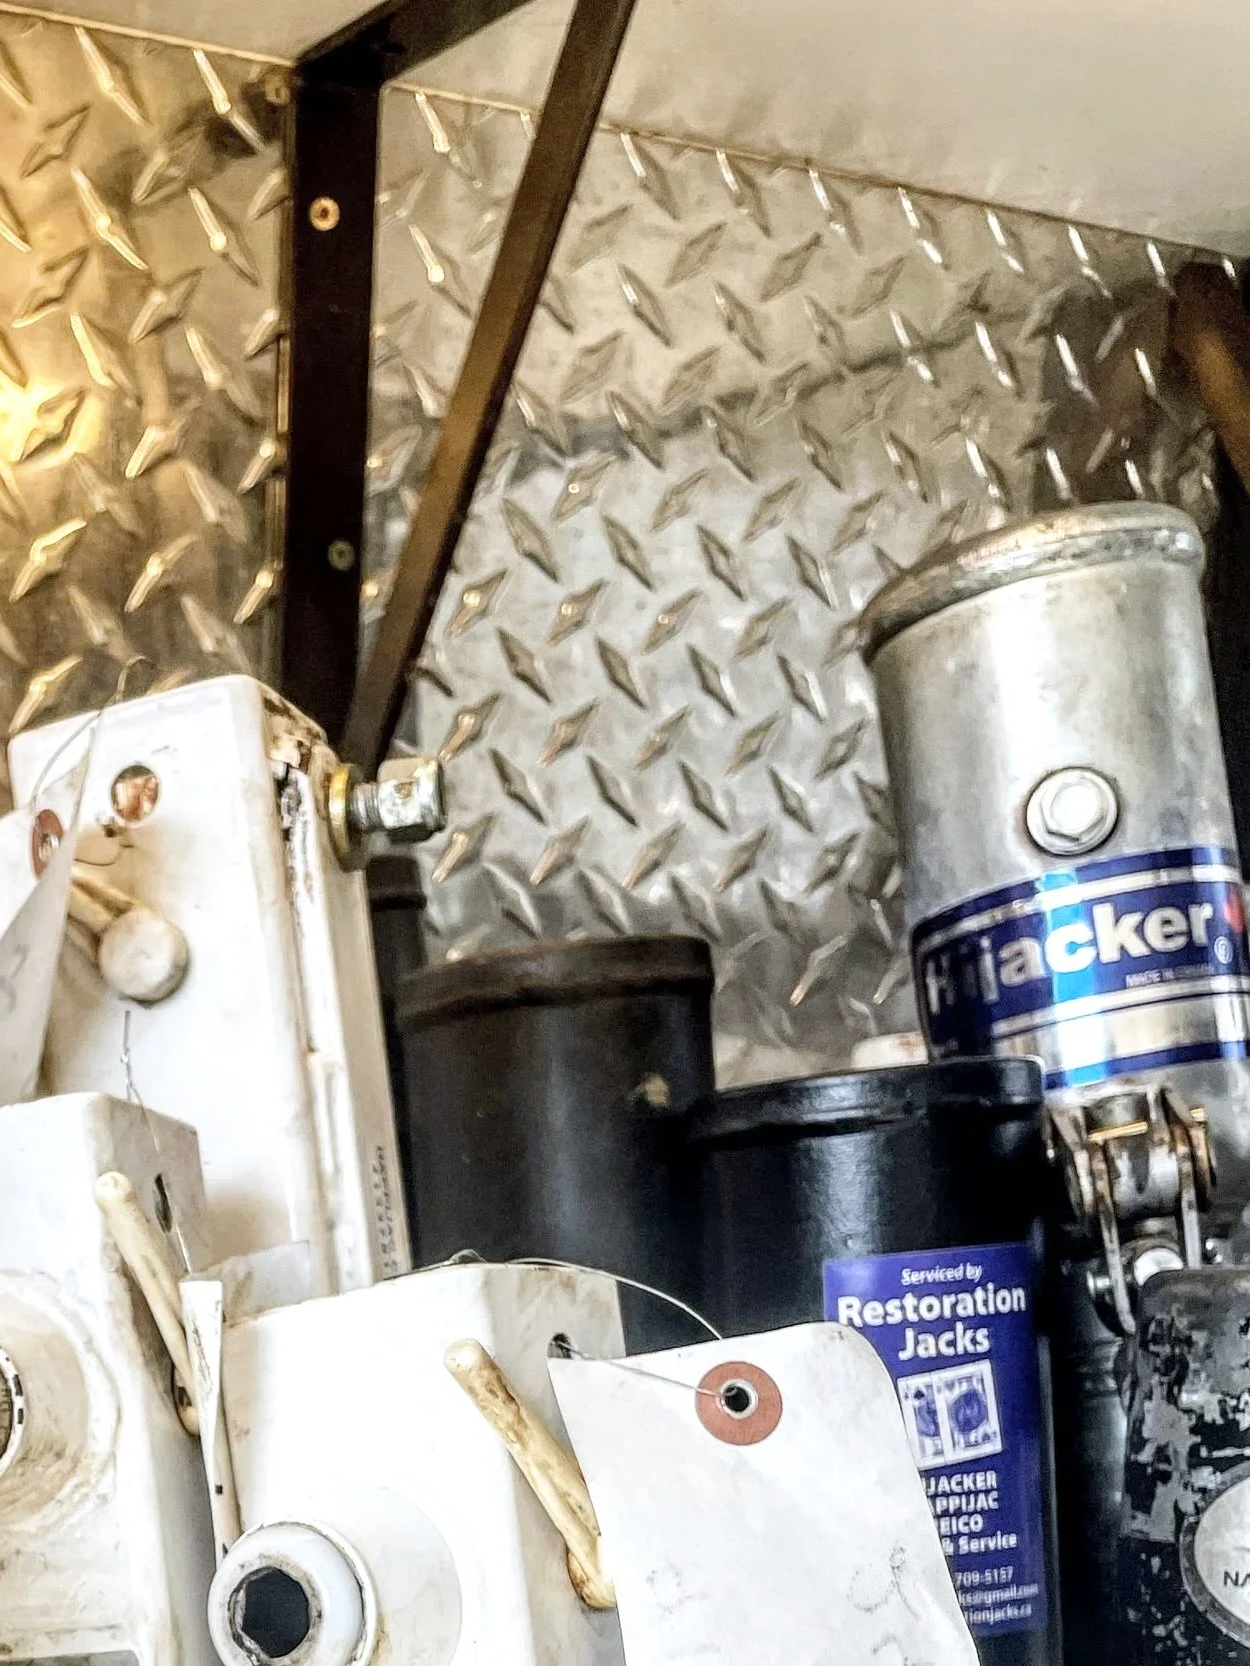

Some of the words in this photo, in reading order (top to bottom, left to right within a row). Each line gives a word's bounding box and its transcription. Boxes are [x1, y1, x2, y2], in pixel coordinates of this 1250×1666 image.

[901, 1263, 963, 1286] Serviced
[966, 1262, 982, 1283] by
[838, 1282, 1026, 1328] Restoration
[898, 1321, 990, 1360] Jacks
[922, 1470, 997, 1496] JACKER
[928, 1491, 999, 1515] PPIJAC
[936, 1513, 983, 1535] EICO
[959, 1530, 1017, 1554] Service
